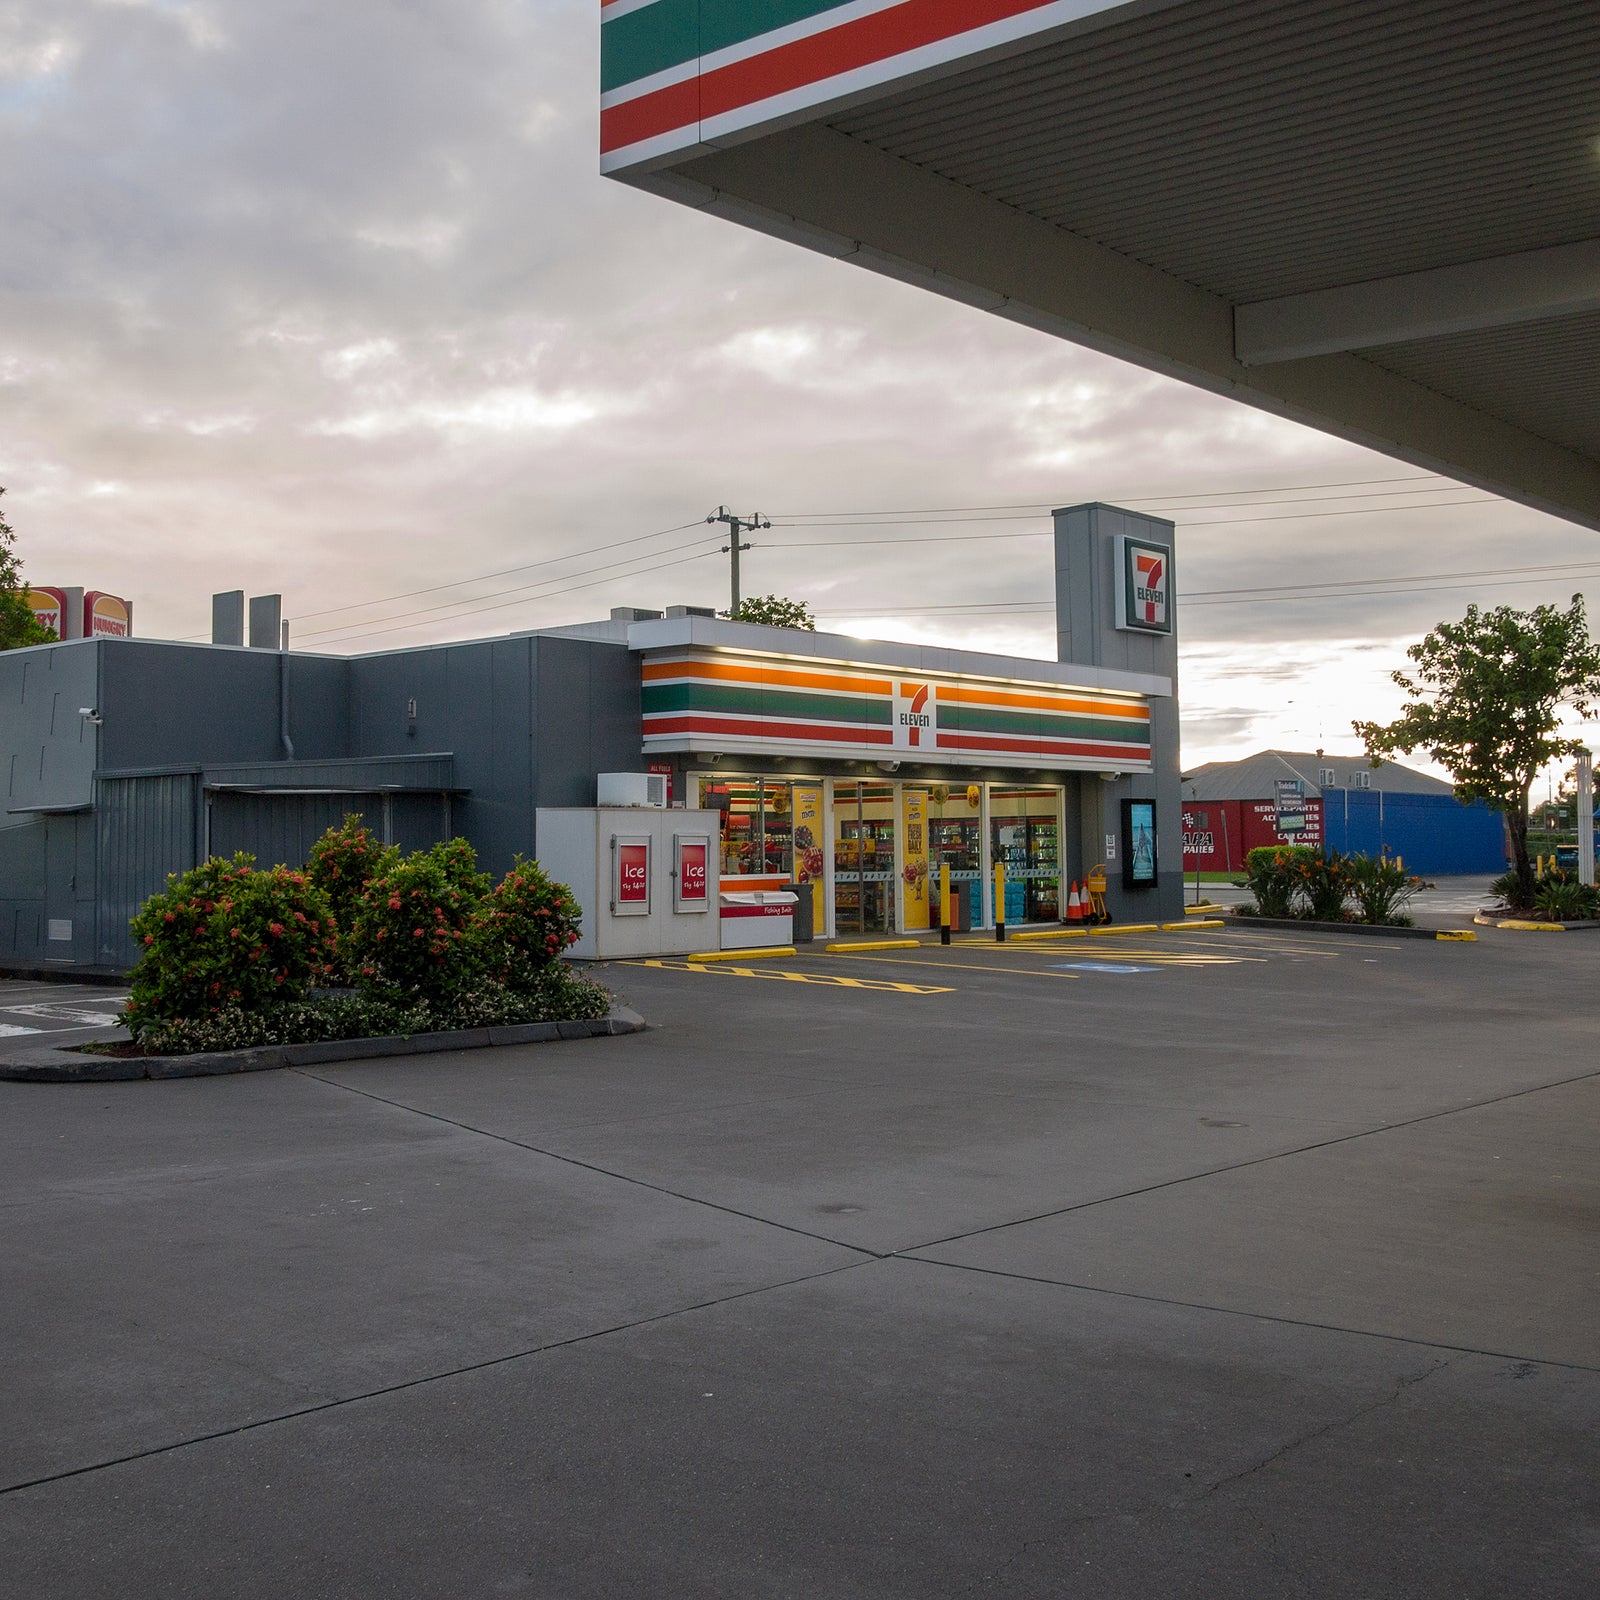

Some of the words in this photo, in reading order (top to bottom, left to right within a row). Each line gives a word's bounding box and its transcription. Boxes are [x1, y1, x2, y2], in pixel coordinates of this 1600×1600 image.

[94, 617, 127, 637] HUNGRY
[1296, 832, 1320, 840] CARE
[625, 864, 645, 878] Ice
[686, 863, 704, 877] Ice
[764, 906, 780, 915] Fishing
[781, 906, 792, 914] Bait
